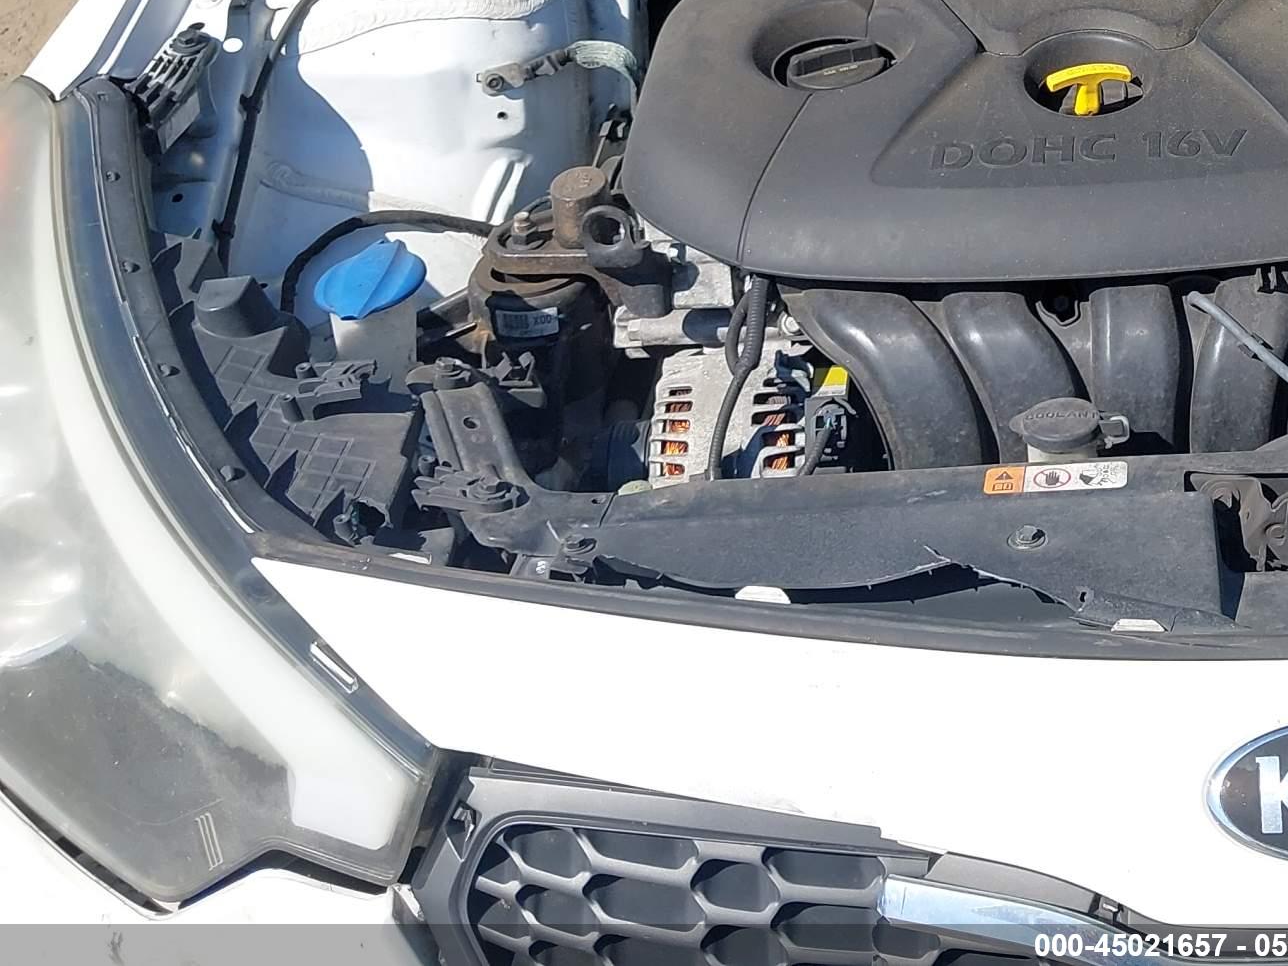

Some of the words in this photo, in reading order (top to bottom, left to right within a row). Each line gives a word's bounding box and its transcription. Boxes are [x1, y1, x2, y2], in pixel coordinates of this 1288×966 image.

[930, 134, 1117, 170] DOHC
[1143, 129, 1247, 158] 16V
[1024, 410, 1099, 421] COOLANT
